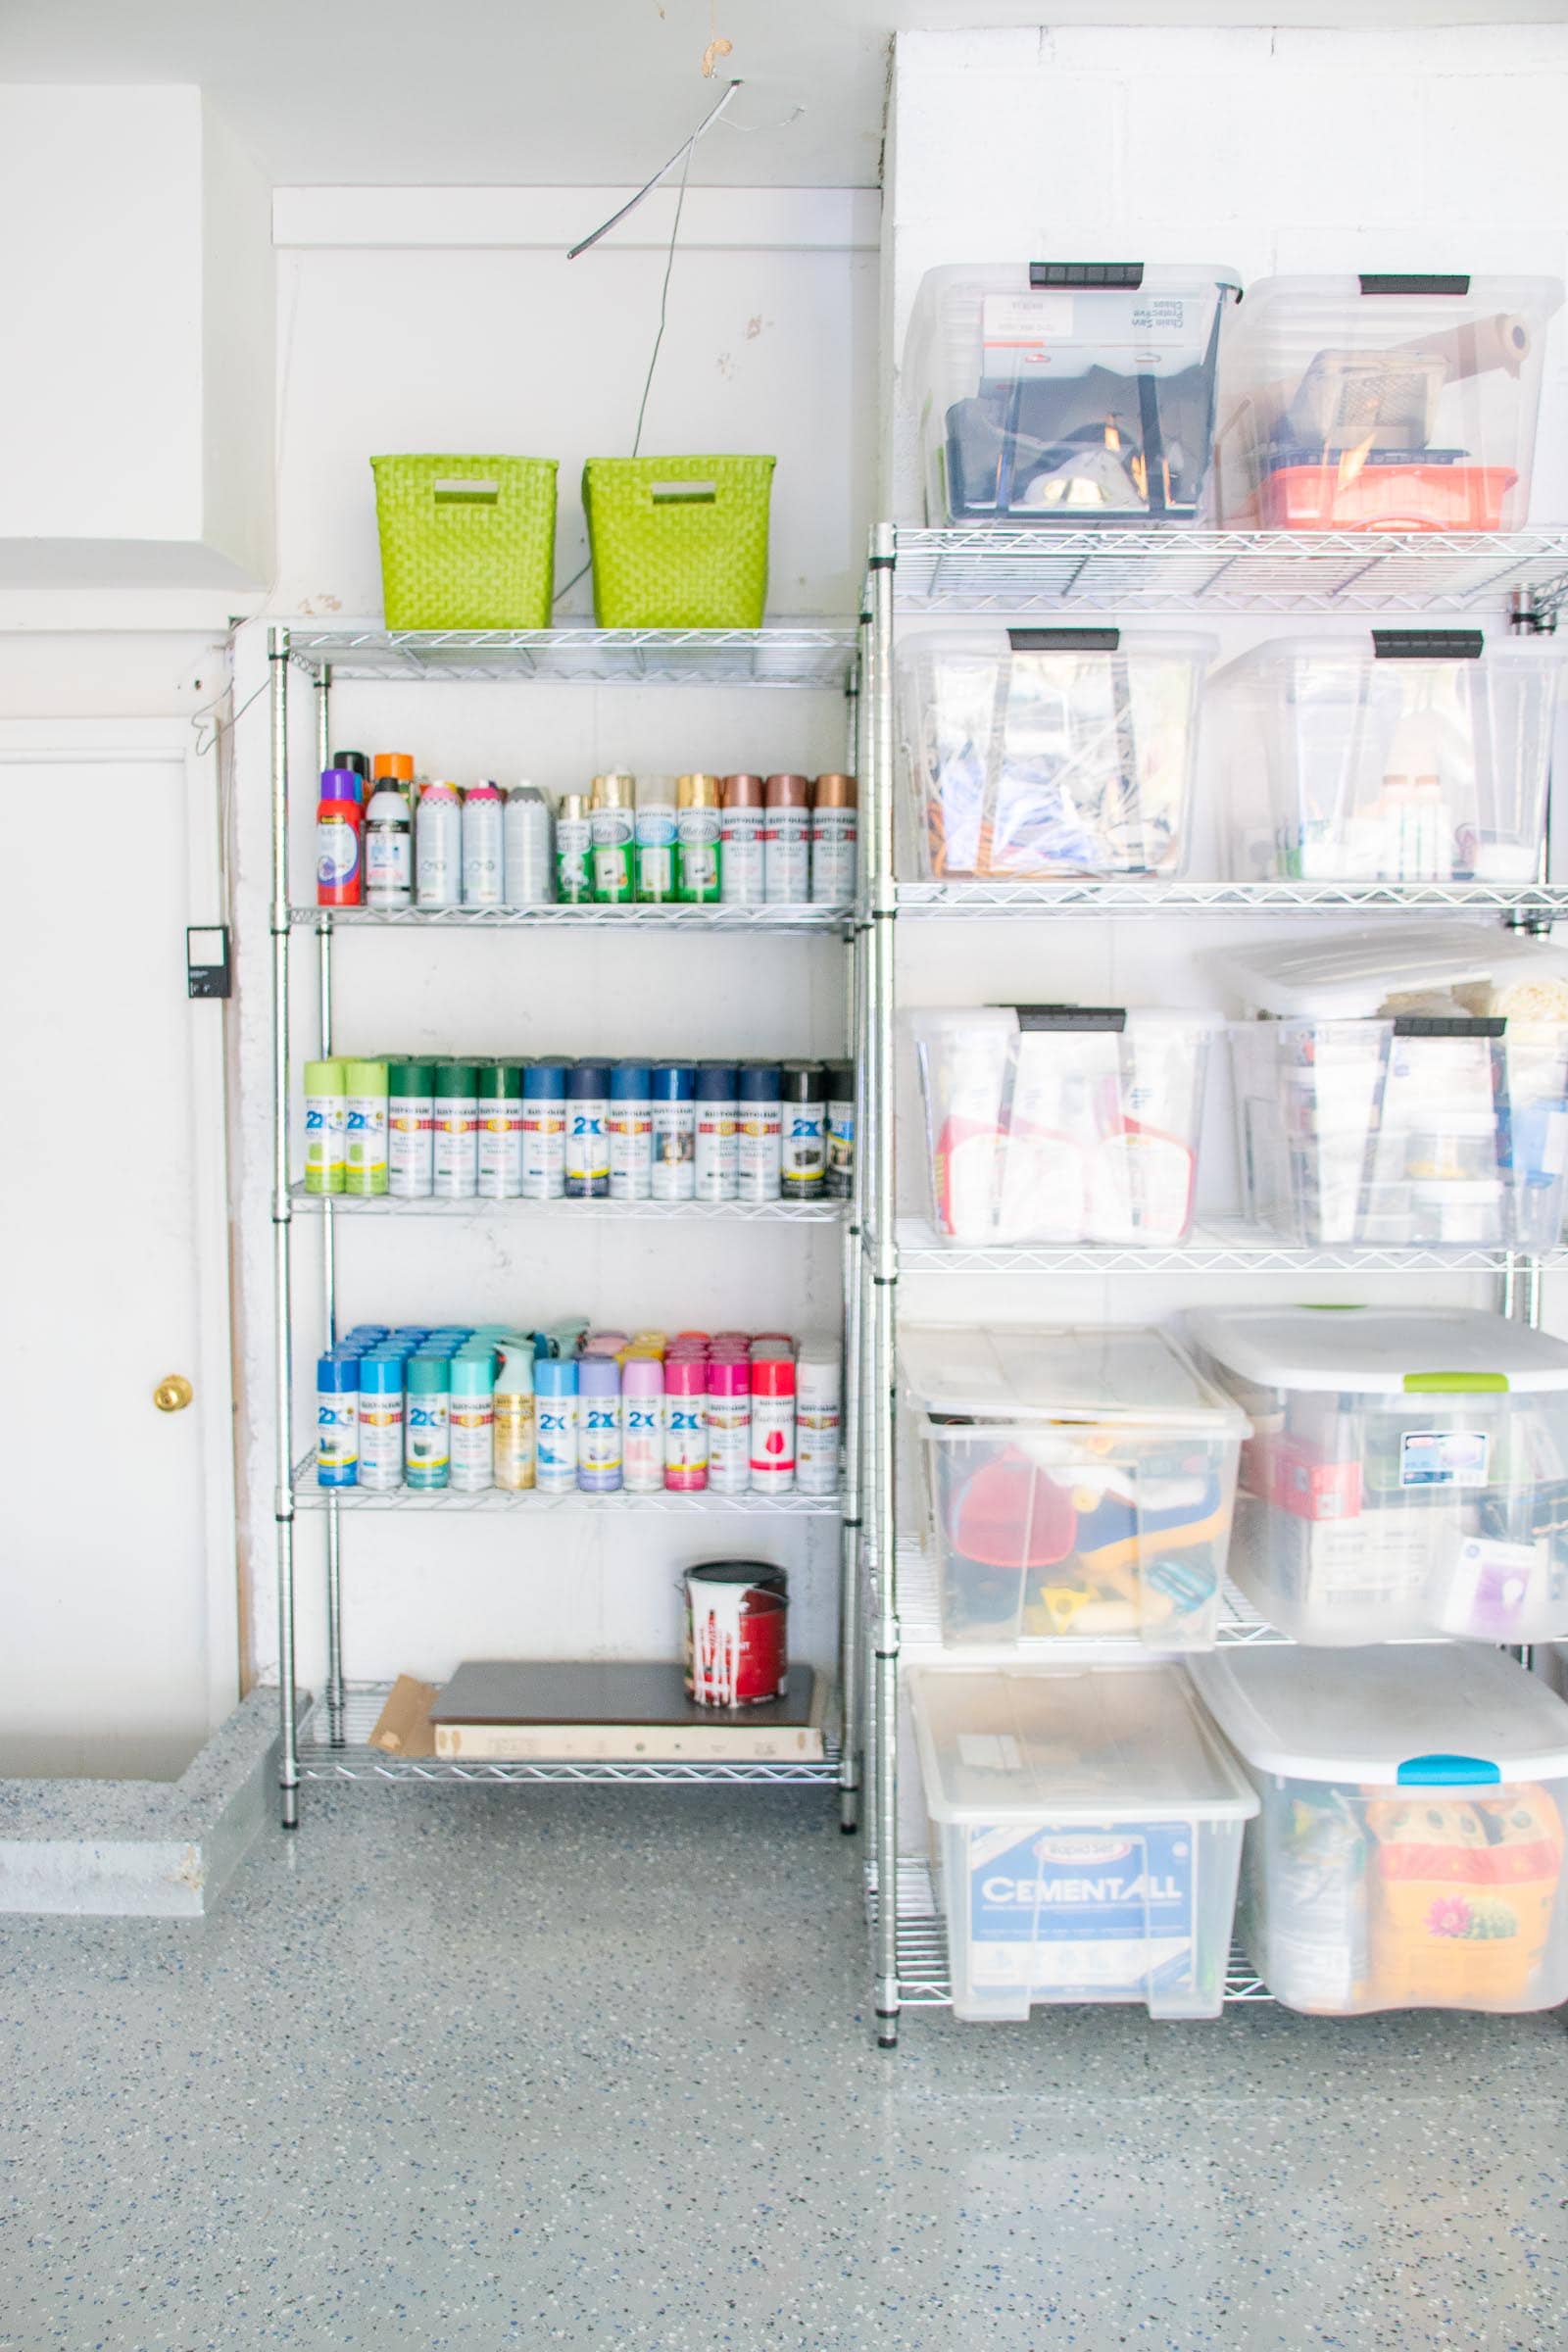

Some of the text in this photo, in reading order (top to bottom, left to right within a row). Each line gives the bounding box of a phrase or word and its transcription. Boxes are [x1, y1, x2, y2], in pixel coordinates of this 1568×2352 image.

[573, 1115, 601, 1135] 2X
[792, 1118, 819, 1137] 2X
[540, 1413, 565, 1431] 2X
[587, 1410, 615, 1429] 2X
[628, 1411, 655, 1428] 2X
[670, 1411, 700, 1430] 2X
